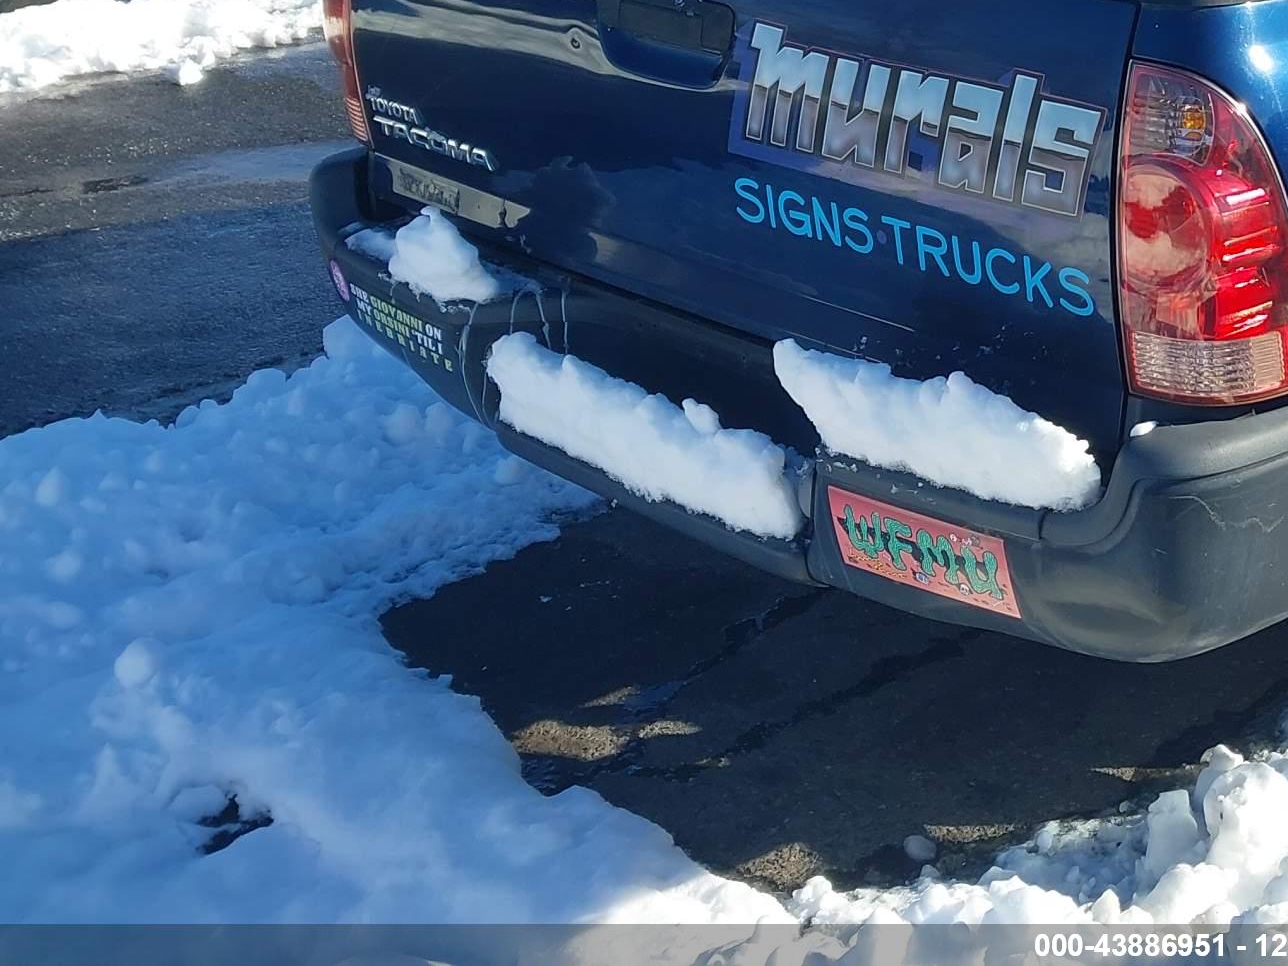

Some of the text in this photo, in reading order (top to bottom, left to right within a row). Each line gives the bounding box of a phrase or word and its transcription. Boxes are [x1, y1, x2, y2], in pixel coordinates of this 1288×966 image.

[370, 97, 420, 124] TOYOTA
[745, 22, 1102, 217] murals
[373, 115, 495, 172] TACOMA
[734, 178, 1095, 316] SIGNS TRUCKS
[356, 297, 372, 316] MY
[369, 295, 423, 333] GIOVANNI
[425, 323, 442, 341] ON
[843, 504, 1004, 601] WFMU
